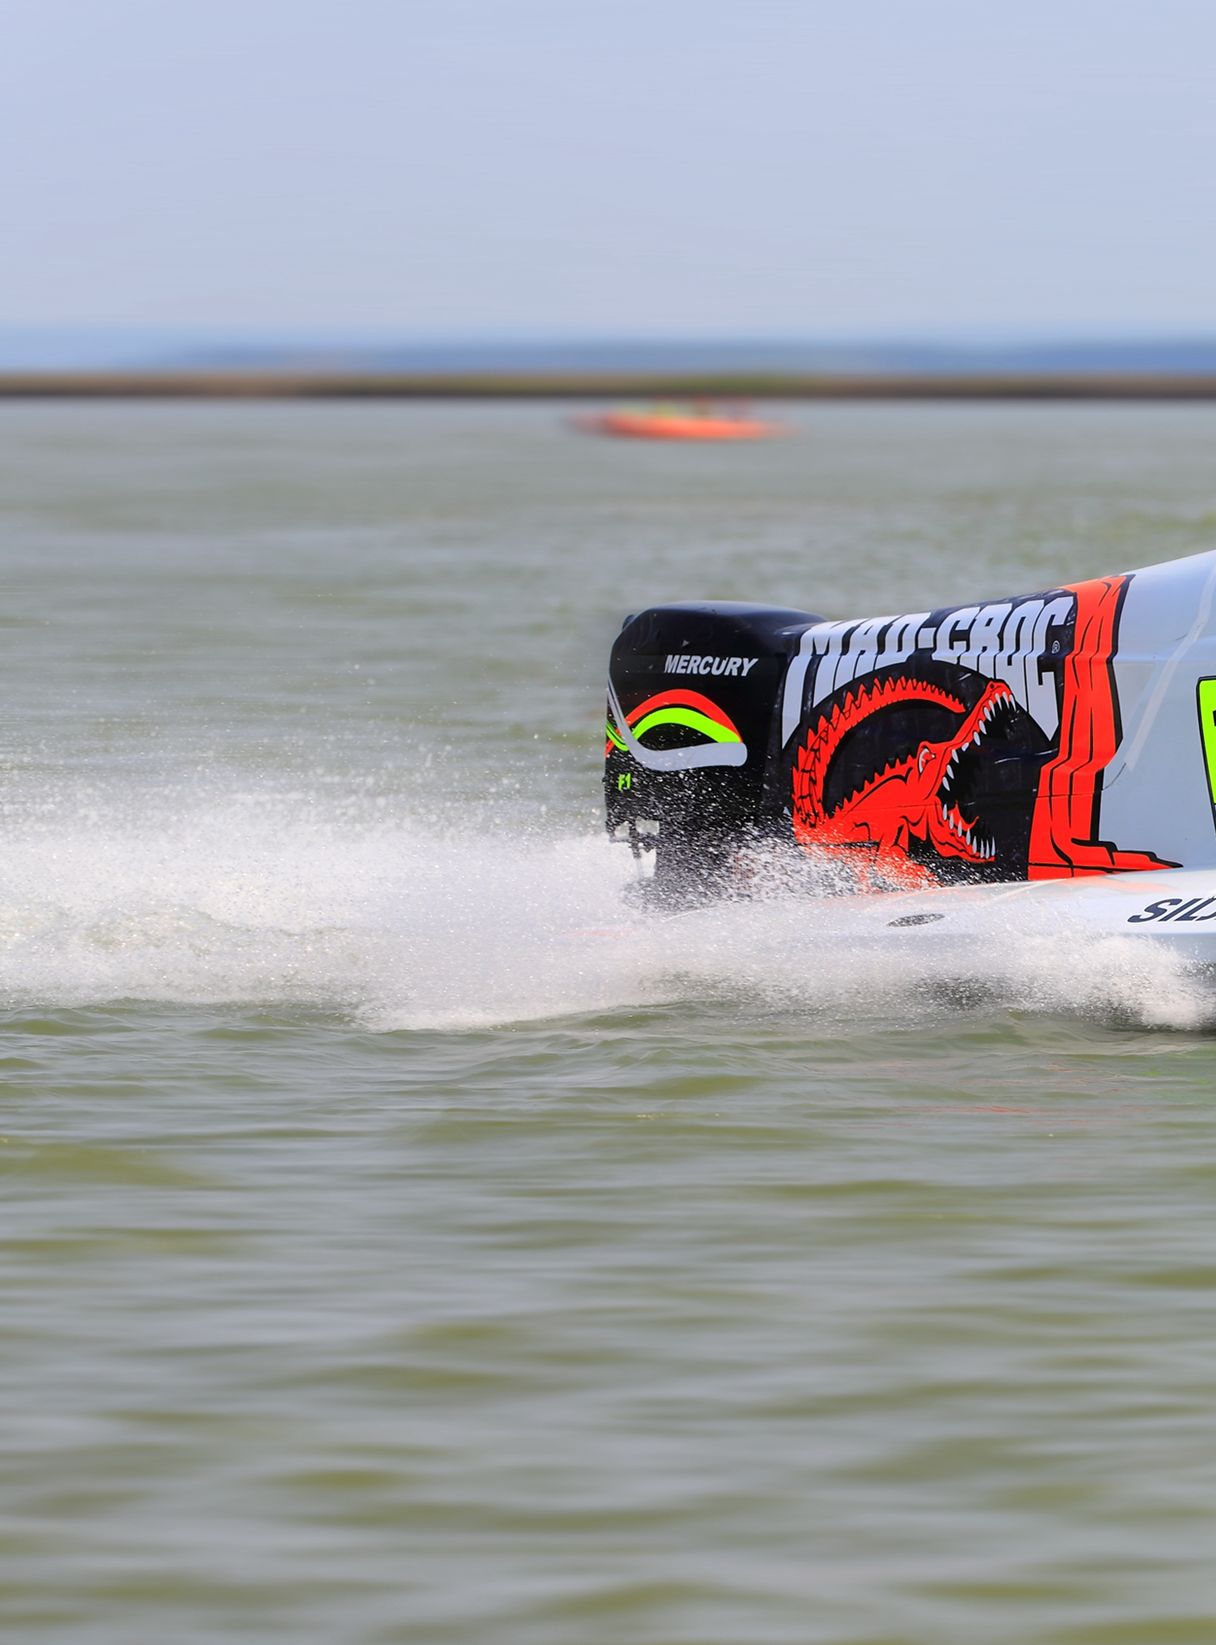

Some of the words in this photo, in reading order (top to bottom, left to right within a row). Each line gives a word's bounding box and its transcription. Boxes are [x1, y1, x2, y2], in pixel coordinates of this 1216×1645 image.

[664, 654, 759, 677] MERCURY
[781, 596, 1073, 749] MAD-CROC
[617, 772, 631, 792] F1
